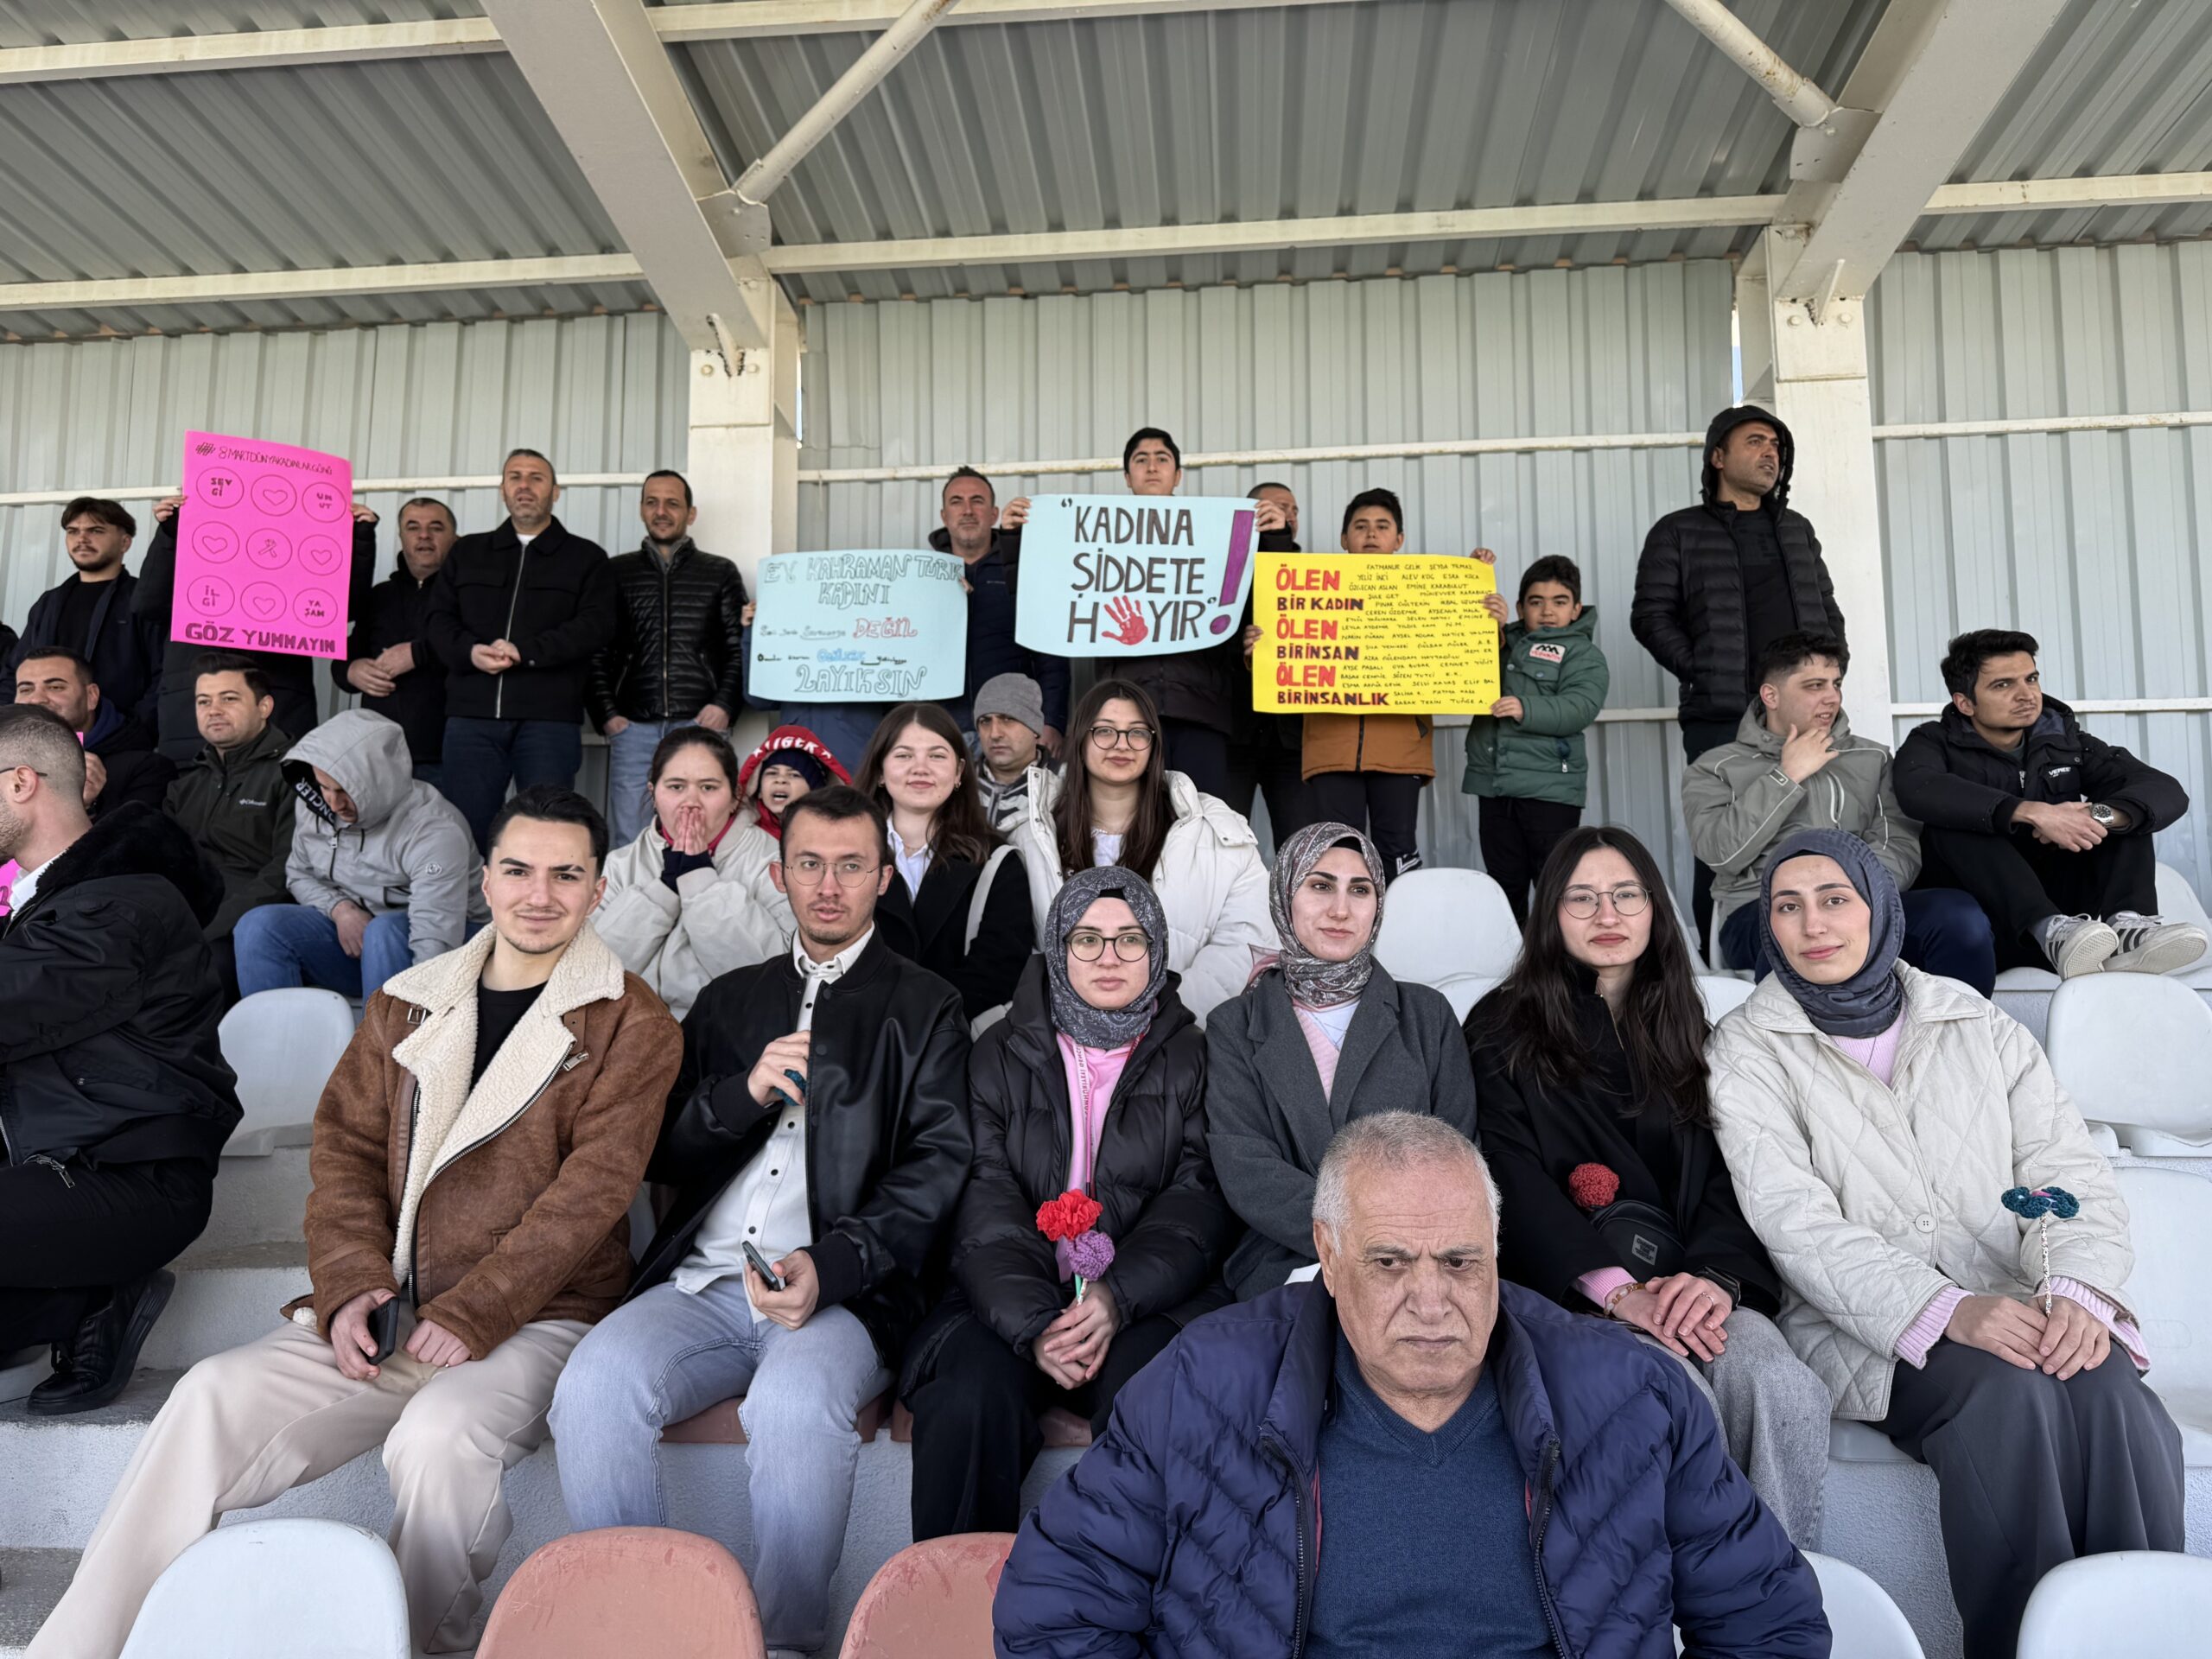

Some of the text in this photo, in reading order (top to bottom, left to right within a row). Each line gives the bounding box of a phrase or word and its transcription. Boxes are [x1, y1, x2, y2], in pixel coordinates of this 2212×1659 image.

[211, 477, 232, 486] SEV
[806, 553, 912, 582] KAHRAMAN
[1071, 548, 1205, 599] ŞİDDETE
[1275, 563, 1341, 591] ÖLEN
[817, 582, 891, 610] KADINI
[1277, 594, 1364, 611] BİR KADIN
[185, 620, 235, 643] GÖZ
[1276, 613, 1338, 640] ÖLEN
[1276, 661, 1337, 688] ÖLEN
